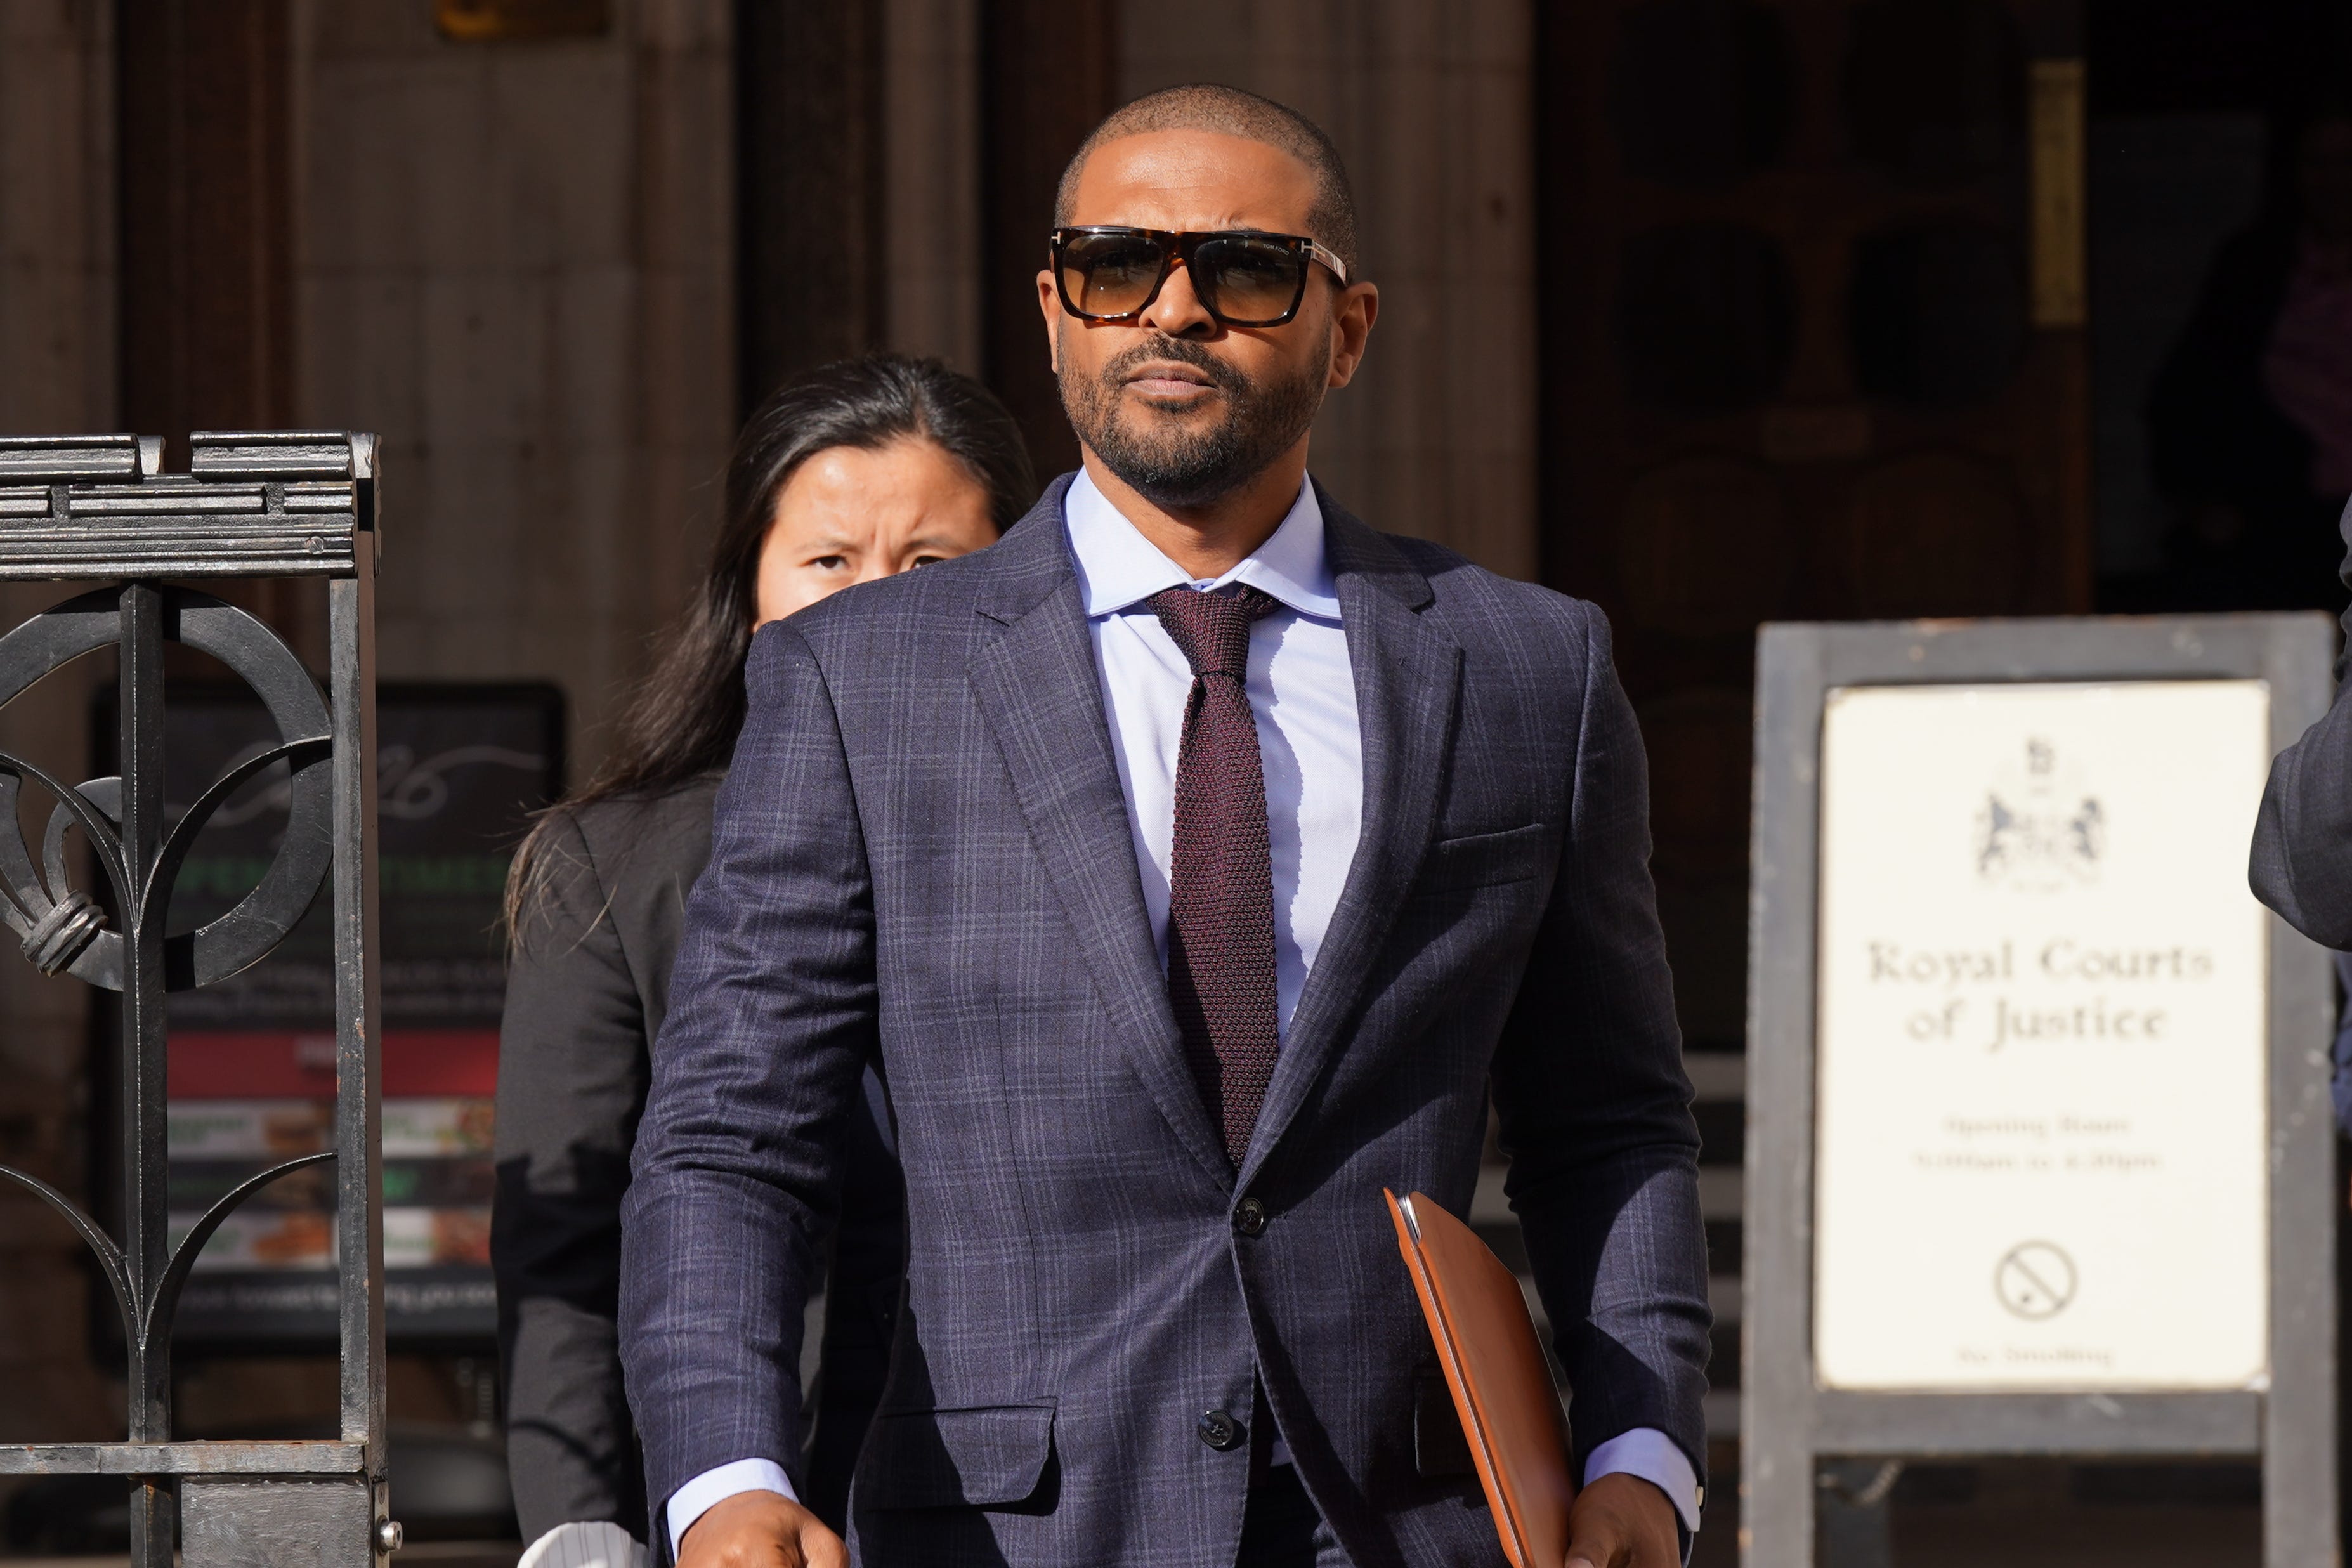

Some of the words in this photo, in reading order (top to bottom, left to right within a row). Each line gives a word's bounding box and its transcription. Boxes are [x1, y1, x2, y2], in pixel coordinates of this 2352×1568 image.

[1868, 938, 2013, 990] Royal
[2038, 936, 2216, 981] Courts
[1905, 997, 1966, 1042] of
[1985, 997, 2168, 1054] Justice
